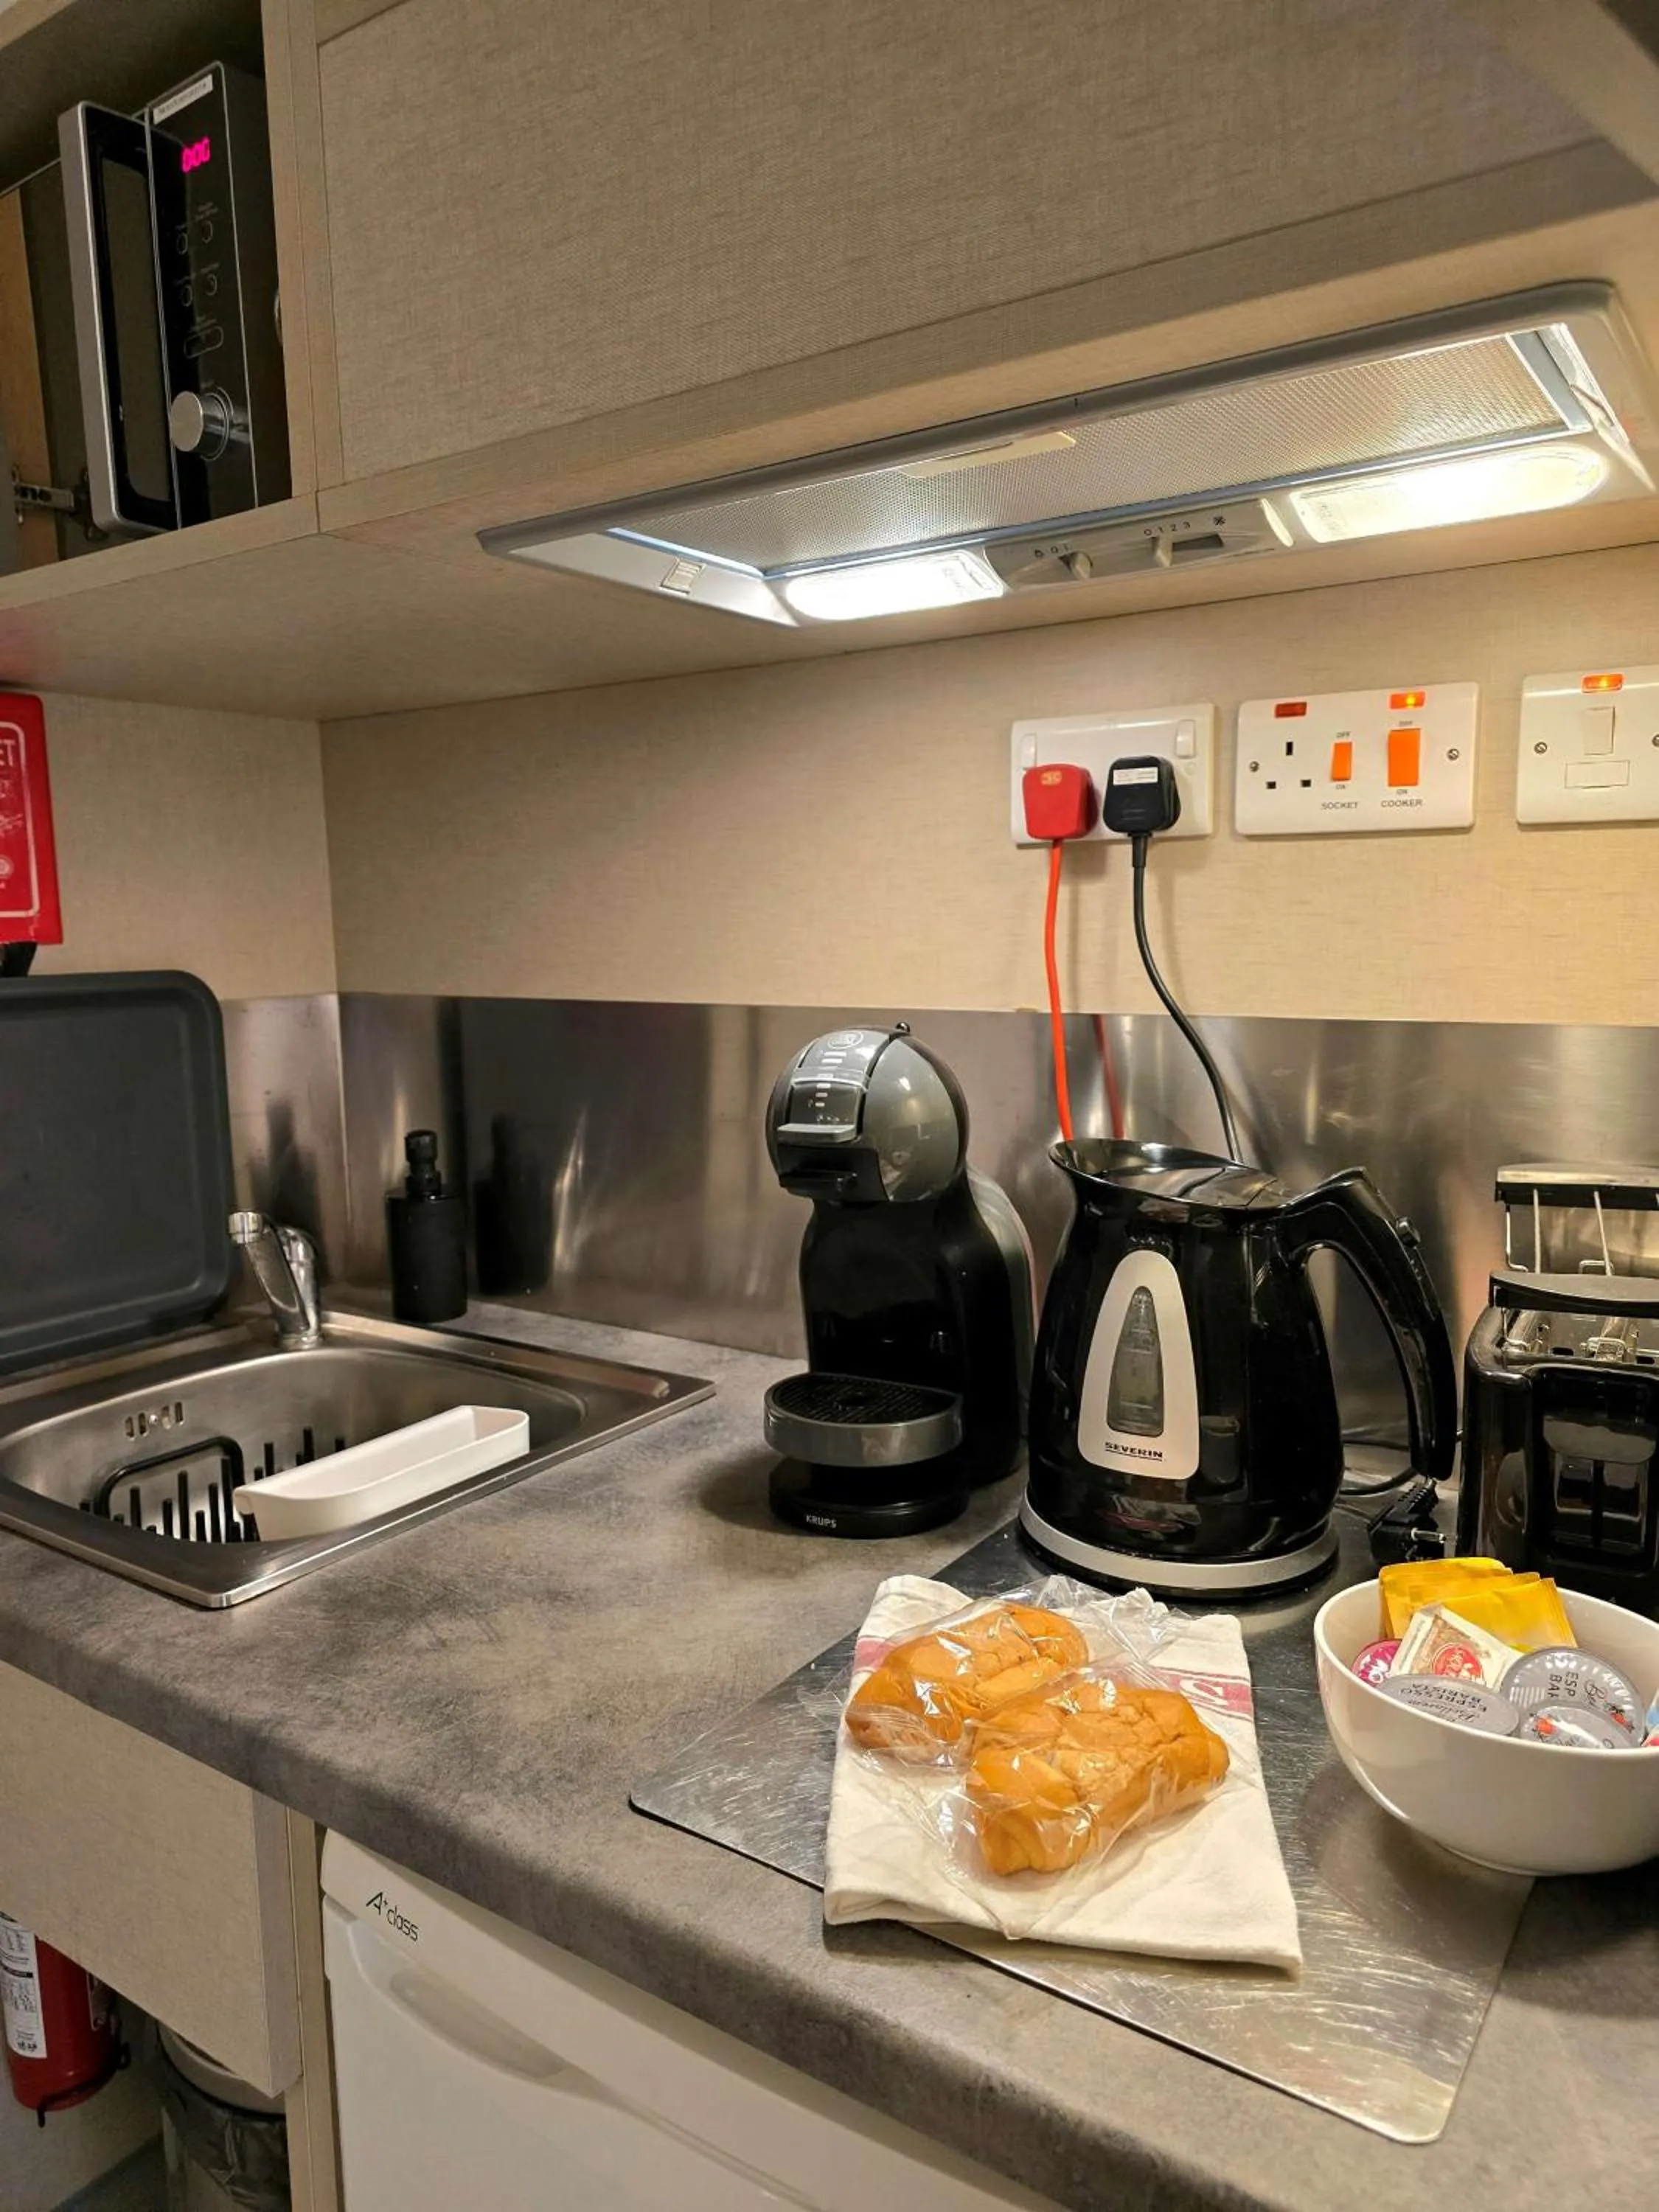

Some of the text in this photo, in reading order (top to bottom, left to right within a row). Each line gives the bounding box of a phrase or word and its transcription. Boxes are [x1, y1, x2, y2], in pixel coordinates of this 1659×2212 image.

[1321, 801, 1358, 810] SOCKET
[1380, 798, 1423, 808] COOKER
[1105, 1441, 1164, 1458] SEVERIN
[806, 1514, 837, 1528] KRUPS
[1400, 1687, 1488, 1713] ESPRESSO
[1411, 1683, 1482, 1705] BARISTA
